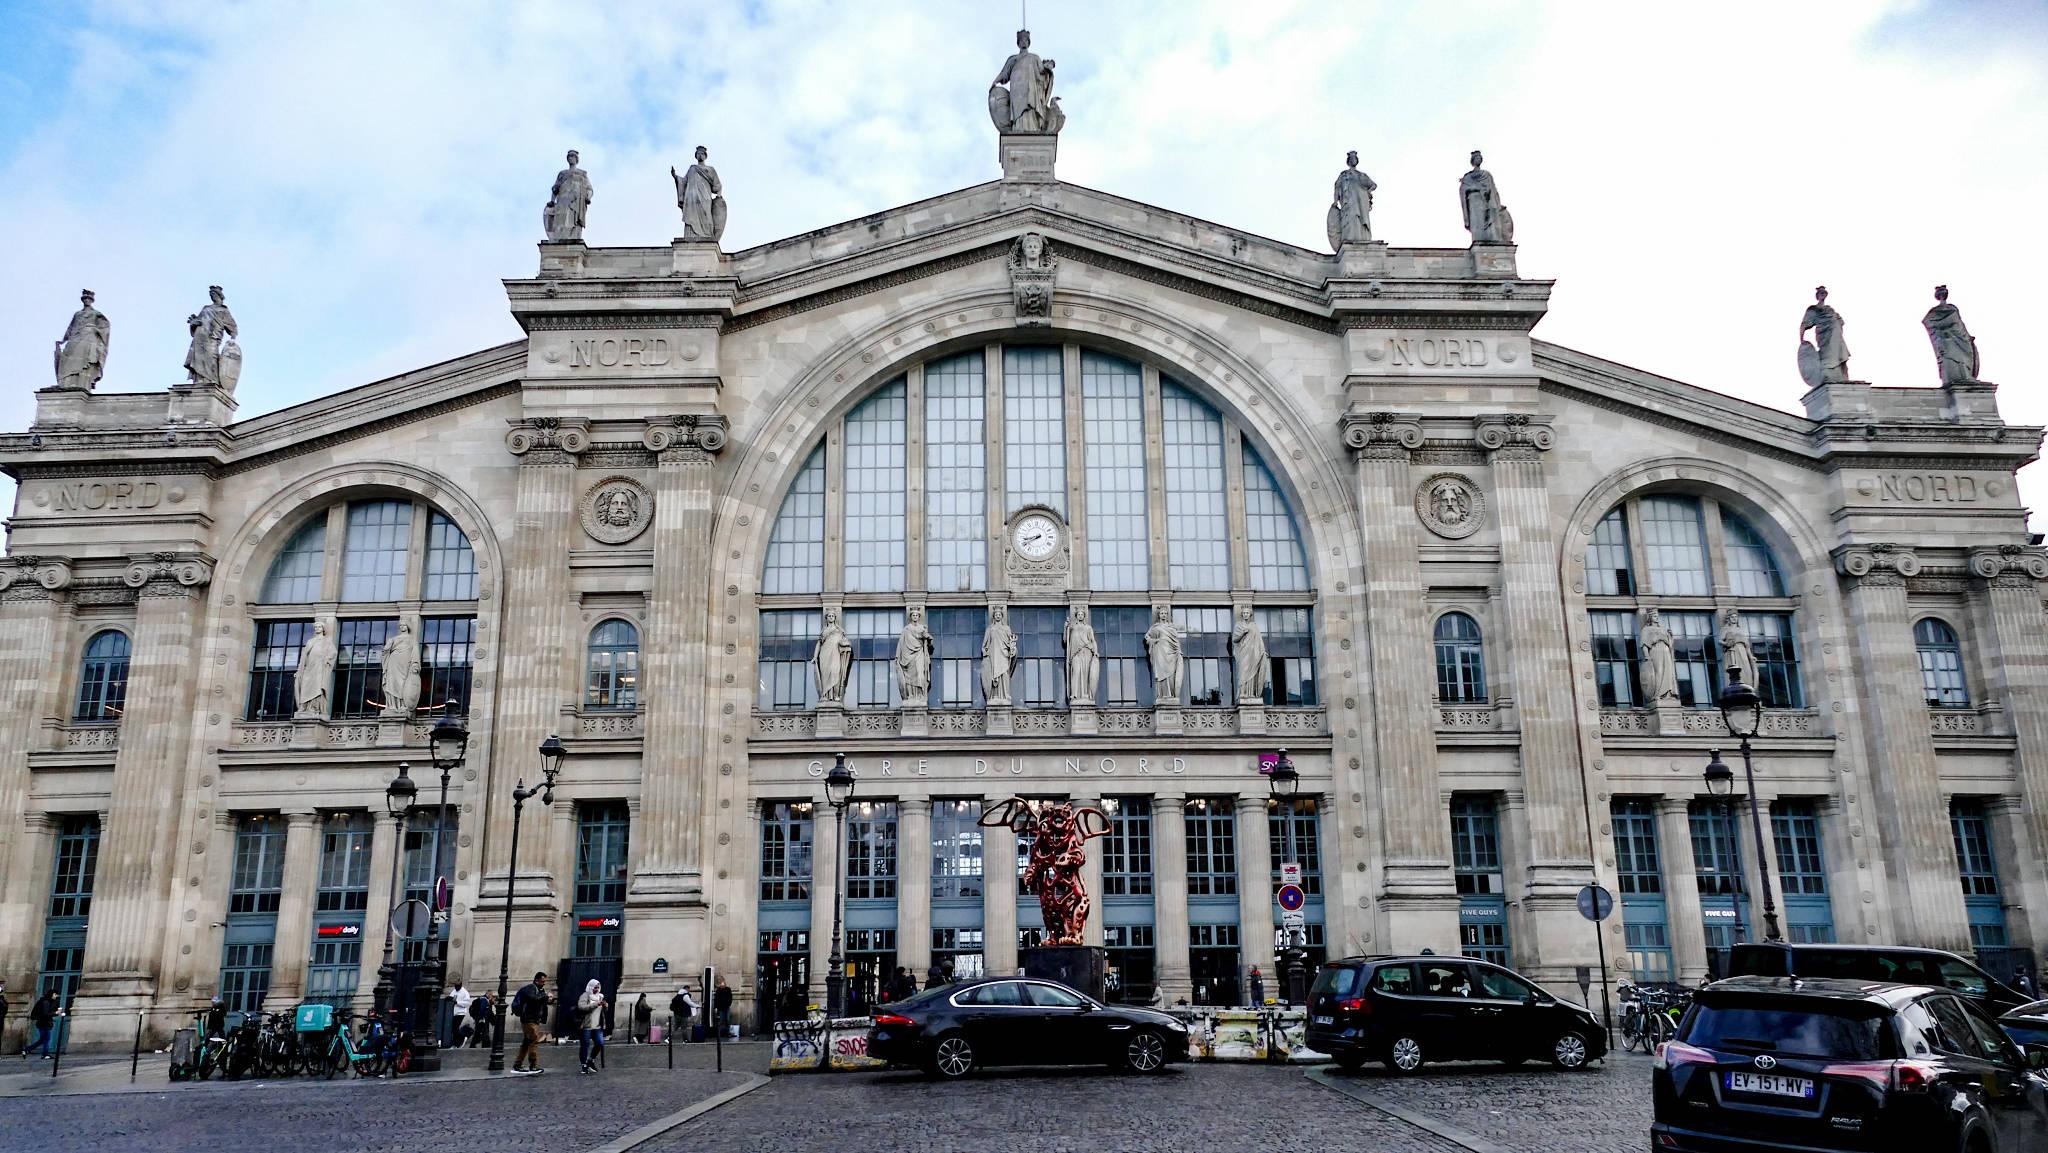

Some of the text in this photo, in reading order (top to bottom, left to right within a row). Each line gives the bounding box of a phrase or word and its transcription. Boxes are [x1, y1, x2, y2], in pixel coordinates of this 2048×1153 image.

[569, 339, 672, 367] NORD
[1389, 338, 1488, 367] NORD
[55, 482, 162, 511] NORD
[1877, 475, 1977, 502] NORD
[808, 757, 1186, 777] GARE DU NORD
[603, 918, 619, 927] daily
[1461, 909, 1498, 917] FIVE GUYS
[343, 925, 359, 935] daily
